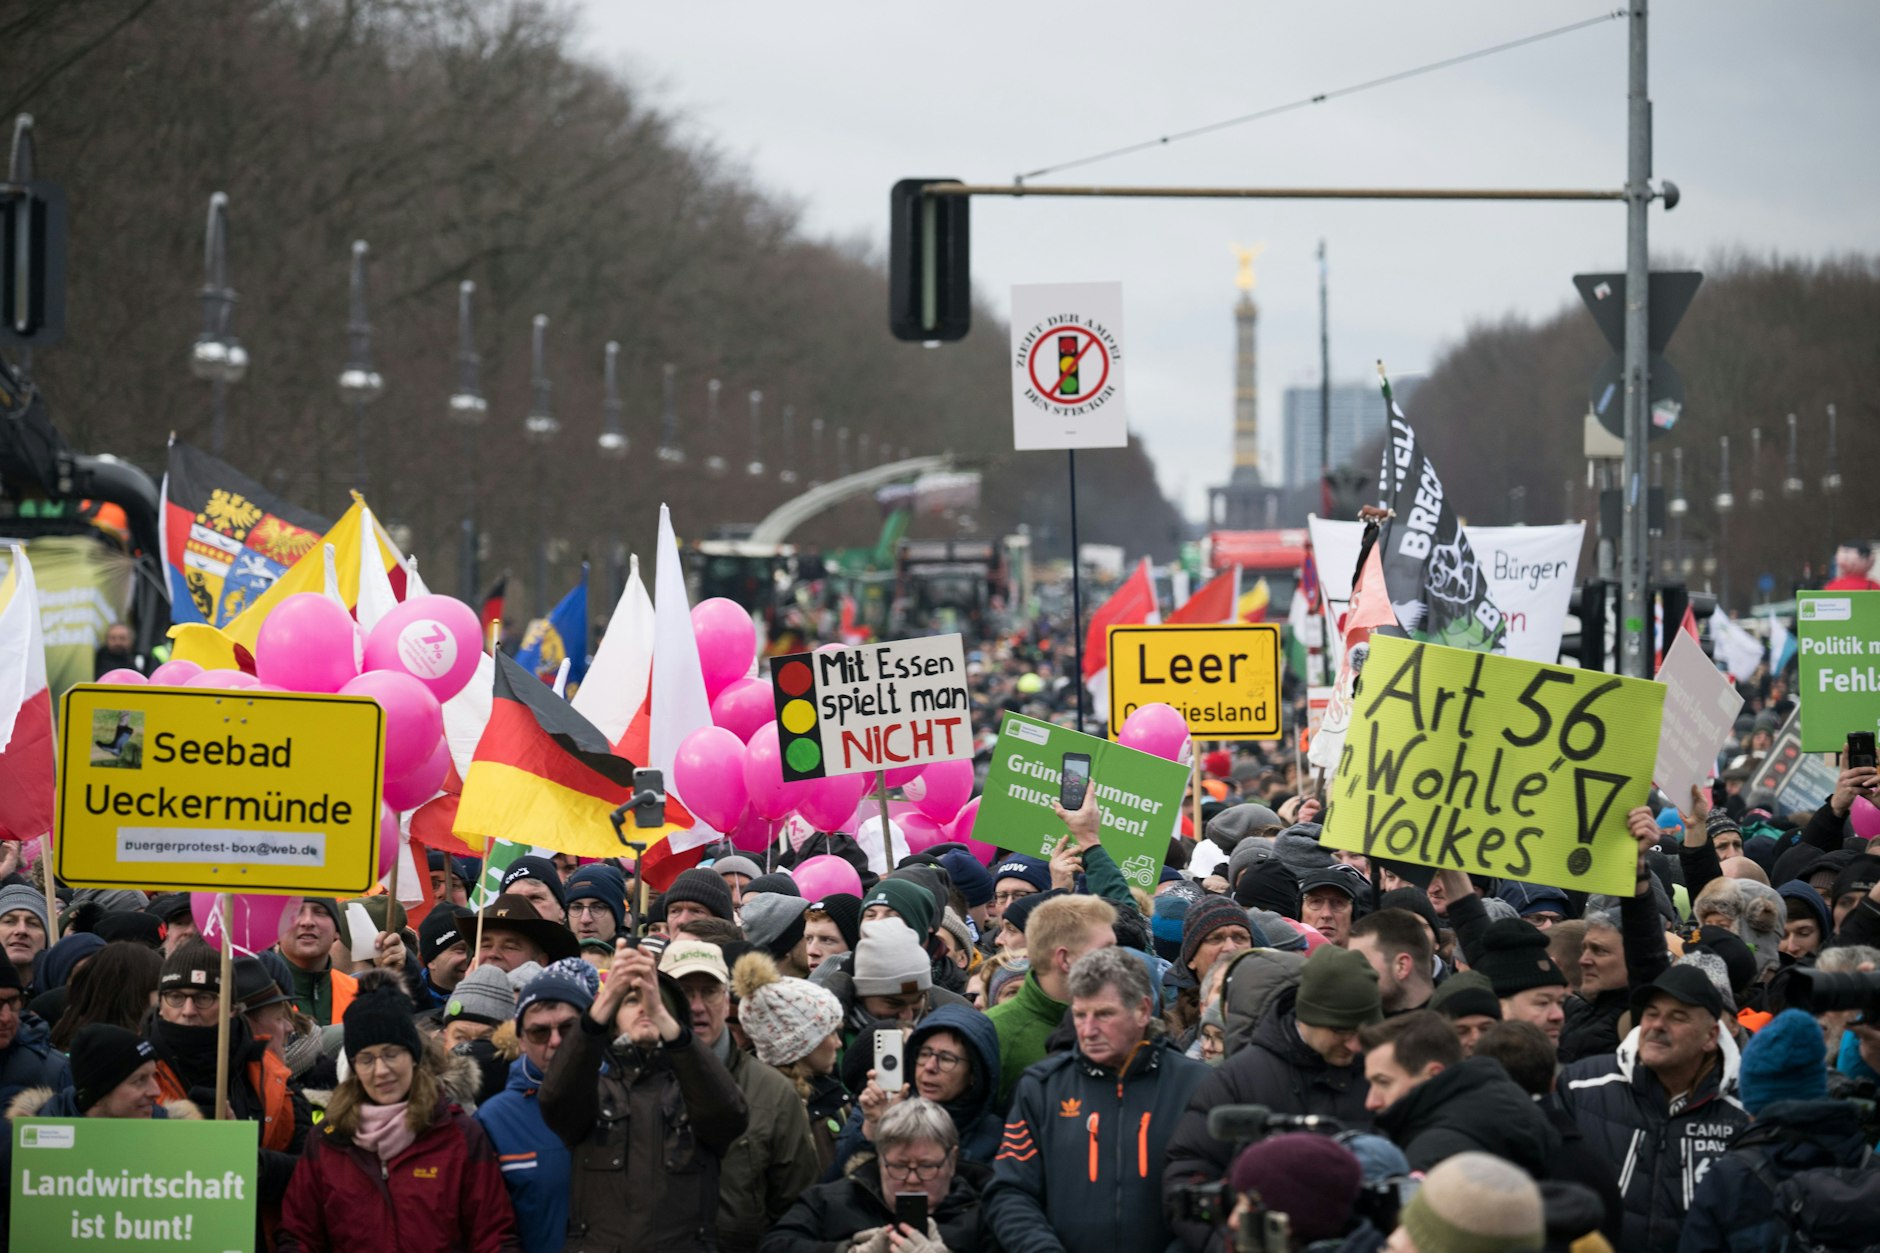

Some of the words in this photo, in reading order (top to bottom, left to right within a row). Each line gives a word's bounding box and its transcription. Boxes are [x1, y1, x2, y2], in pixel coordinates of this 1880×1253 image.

[1047, 313, 1079, 326] DER
[1084, 319, 1121, 364] AMPEL
[1024, 388, 1049, 412] DEN
[1053, 385, 1116, 417] STECKER
[1494, 549, 1568, 590] Bürger
[1139, 643, 1249, 684] Leer
[1801, 636, 1864, 655] Politik
[819, 650, 870, 686] Mit
[876, 647, 955, 680] Essen
[1819, 667, 1880, 693] Fehl
[821, 682, 902, 726] spielt
[910, 687, 968, 713] man
[1364, 643, 1486, 739] Art
[1501, 668, 1623, 762] 56
[152, 732, 292, 768] Seebad
[841, 716, 962, 769] NICHT
[85, 784, 352, 825] Ueckermünde
[1363, 794, 1545, 878] Volkes
[1685, 1123, 1734, 1138] CAMP
[22, 1169, 245, 1200] Landwirtschaft
[71, 1210, 106, 1239] ist
[114, 1211, 194, 1241] bunt!
